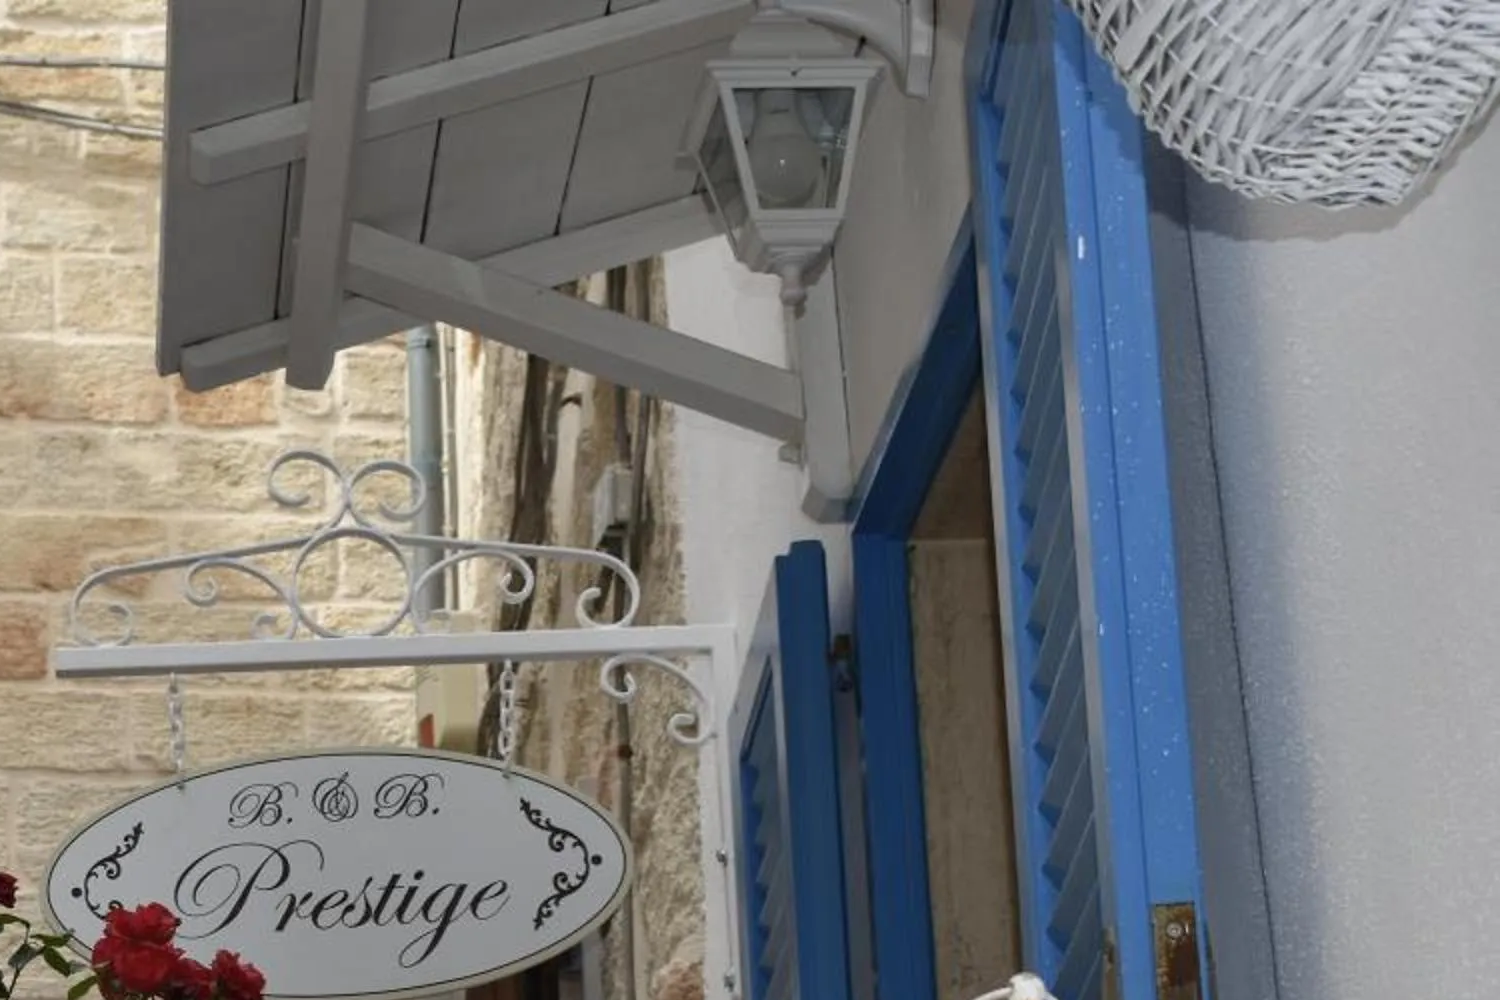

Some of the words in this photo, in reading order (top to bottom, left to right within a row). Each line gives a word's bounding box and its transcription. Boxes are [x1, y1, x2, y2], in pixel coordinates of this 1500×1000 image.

[228, 782, 298, 828] B.
[312, 772, 359, 823] &
[373, 773, 445, 818] B.
[173, 839, 510, 969] Prestige
